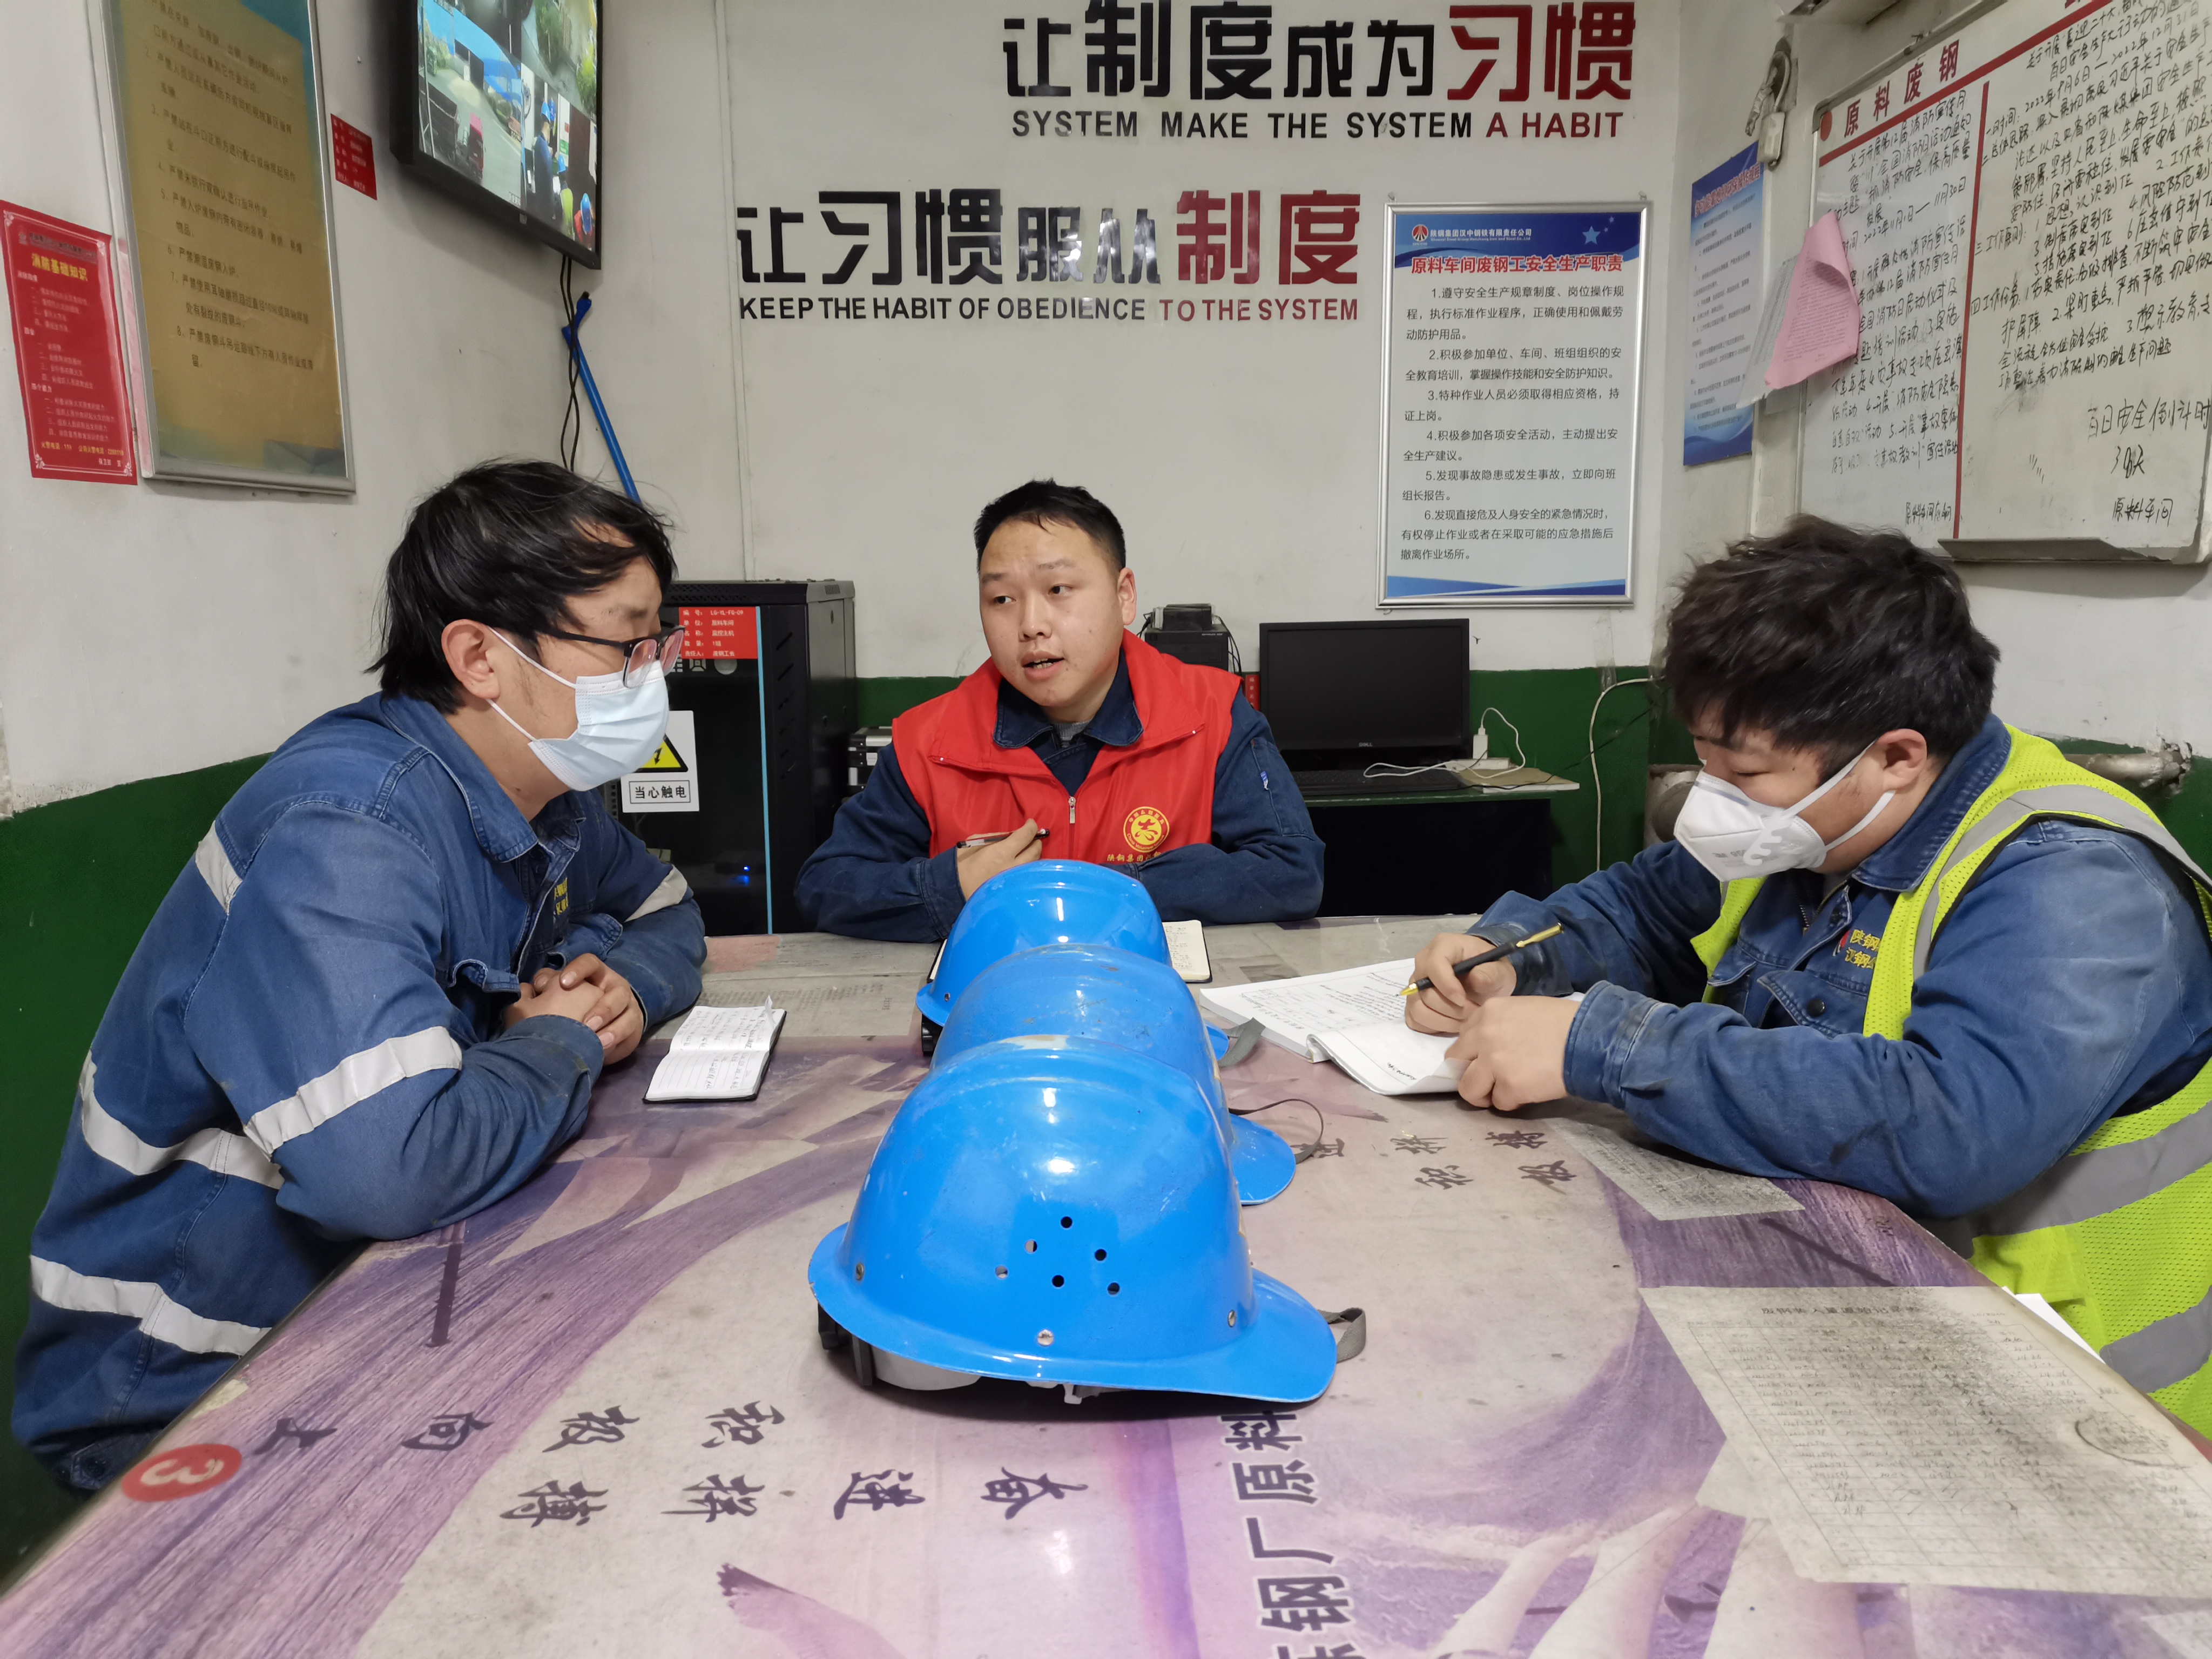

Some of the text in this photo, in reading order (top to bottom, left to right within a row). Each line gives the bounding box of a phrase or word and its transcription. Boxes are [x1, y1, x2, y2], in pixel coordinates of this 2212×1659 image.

[1002, 0, 1636, 102] 让制度成为习惯
[1844, 39, 1959, 138] 原料废钢
[1013, 110, 1623, 138] SYSTEM MAKE THE SYSTEM A HABIT
[737, 188, 1360, 285] 让习惯服从制度
[1411, 254, 1624, 274] 原料车间废钢工安全生产职责
[1432, 286, 1624, 299] 1.遵守安全生产规章制度、岗位操作规
[740, 298, 1358, 321] KEEP THE HABIT OF OBEDIENCE TO THE SYSTEM
[1406, 307, 1623, 321] 程，执行标准作业程序，正确使用和佩戴劳
[1406, 329, 1467, 340] 动防护用品。
[1429, 347, 1622, 360] 2.积极参加单位、车间、班组组织的安
[1405, 368, 1614, 381] 全教育培训，掌握操作技能和安全防护知识。
[1428, 388, 1620, 401] 3.特种作业人员必须取得相应资格，持
[1404, 410, 1442, 422] 证上岗。
[2088, 396, 2211, 442] 百日安全倒计时
[1426, 428, 1618, 442] 4.积极参加各项安全活动，主动提出安
[1404, 450, 1463, 462] 全生产建议。
[1426, 469, 1616, 481] 5.发现事故隐患或发生事故，立即向班
[1402, 490, 1452, 501] 组长报告。
[1424, 509, 1608, 521] 6.发现直接危及人身安全的紧急情况时，
[2112, 497, 2173, 527] 原料车间
[1401, 528, 1614, 541] 有权停止作业或者在采取可能的应急措施后
[1401, 549, 1471, 561] 撤离作业场所。
[635, 785, 687, 799] 当心触电
[1850, 929, 1882, 952] 陕钢
